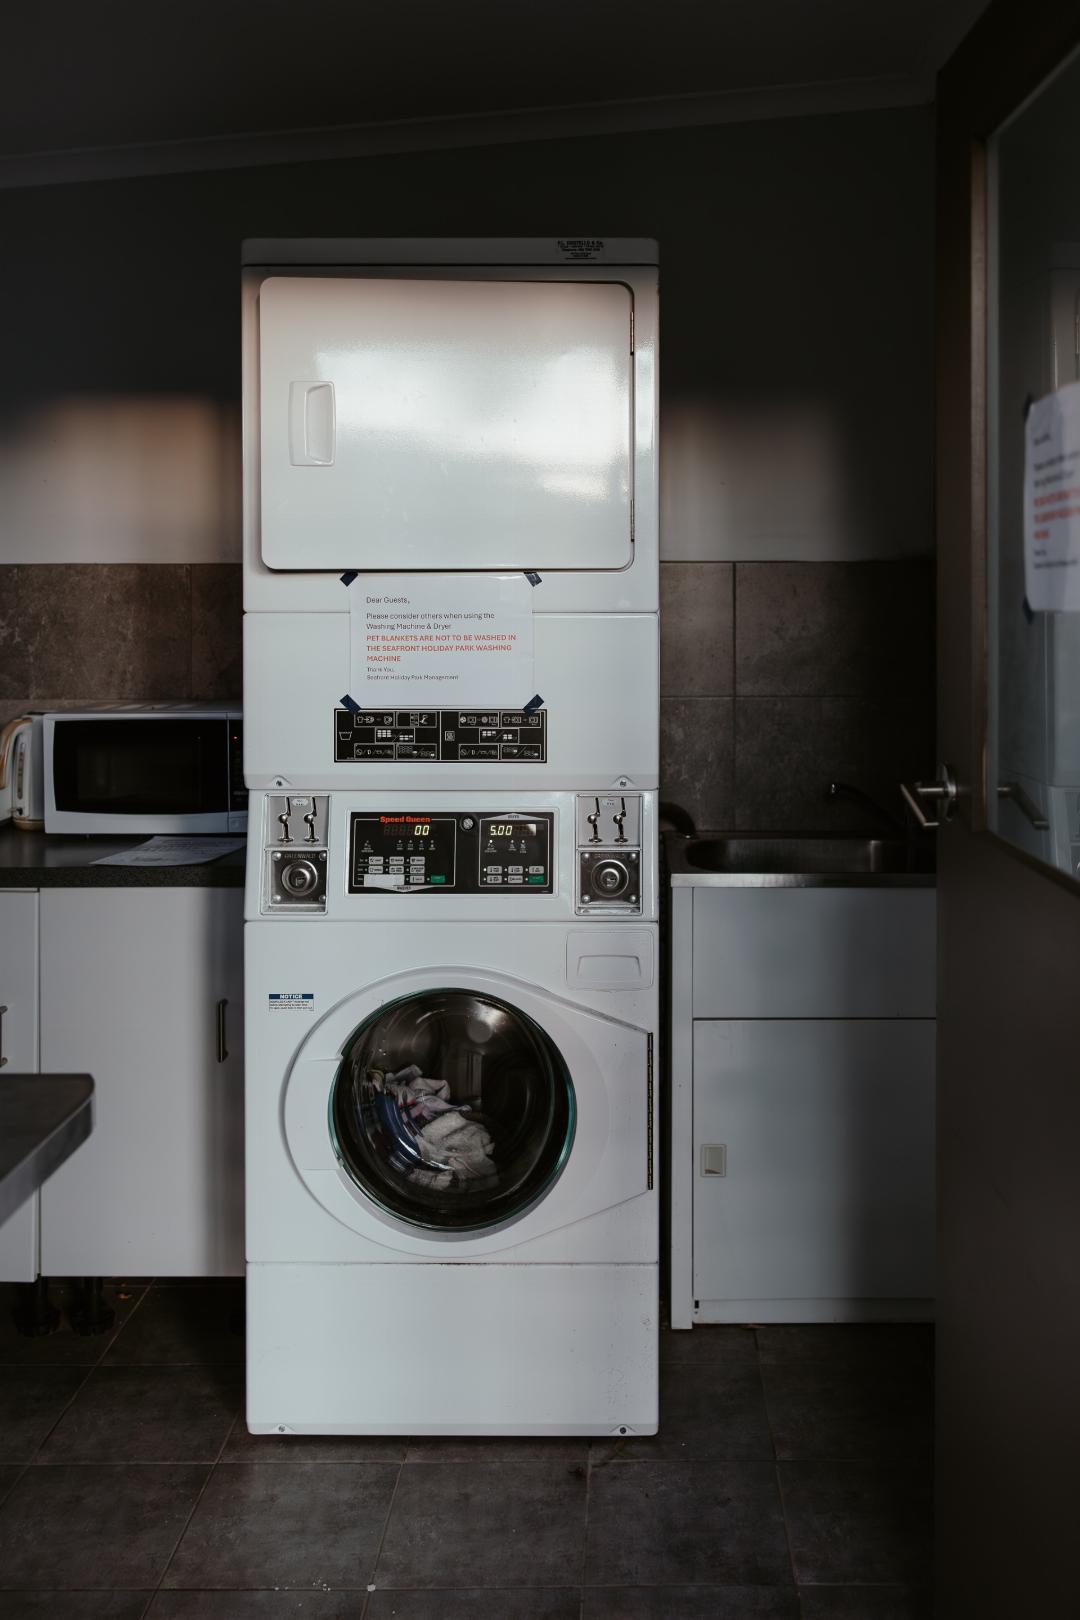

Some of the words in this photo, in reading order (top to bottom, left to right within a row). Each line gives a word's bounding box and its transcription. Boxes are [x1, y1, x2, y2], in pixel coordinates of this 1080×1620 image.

[384, 596, 410, 604] Guests,
[463, 612, 482, 620] using
[434, 622, 452, 630] Dryer
[380, 816, 404, 824] Speed
[414, 825, 430, 836] 00
[490, 825, 512, 836] 5.00
